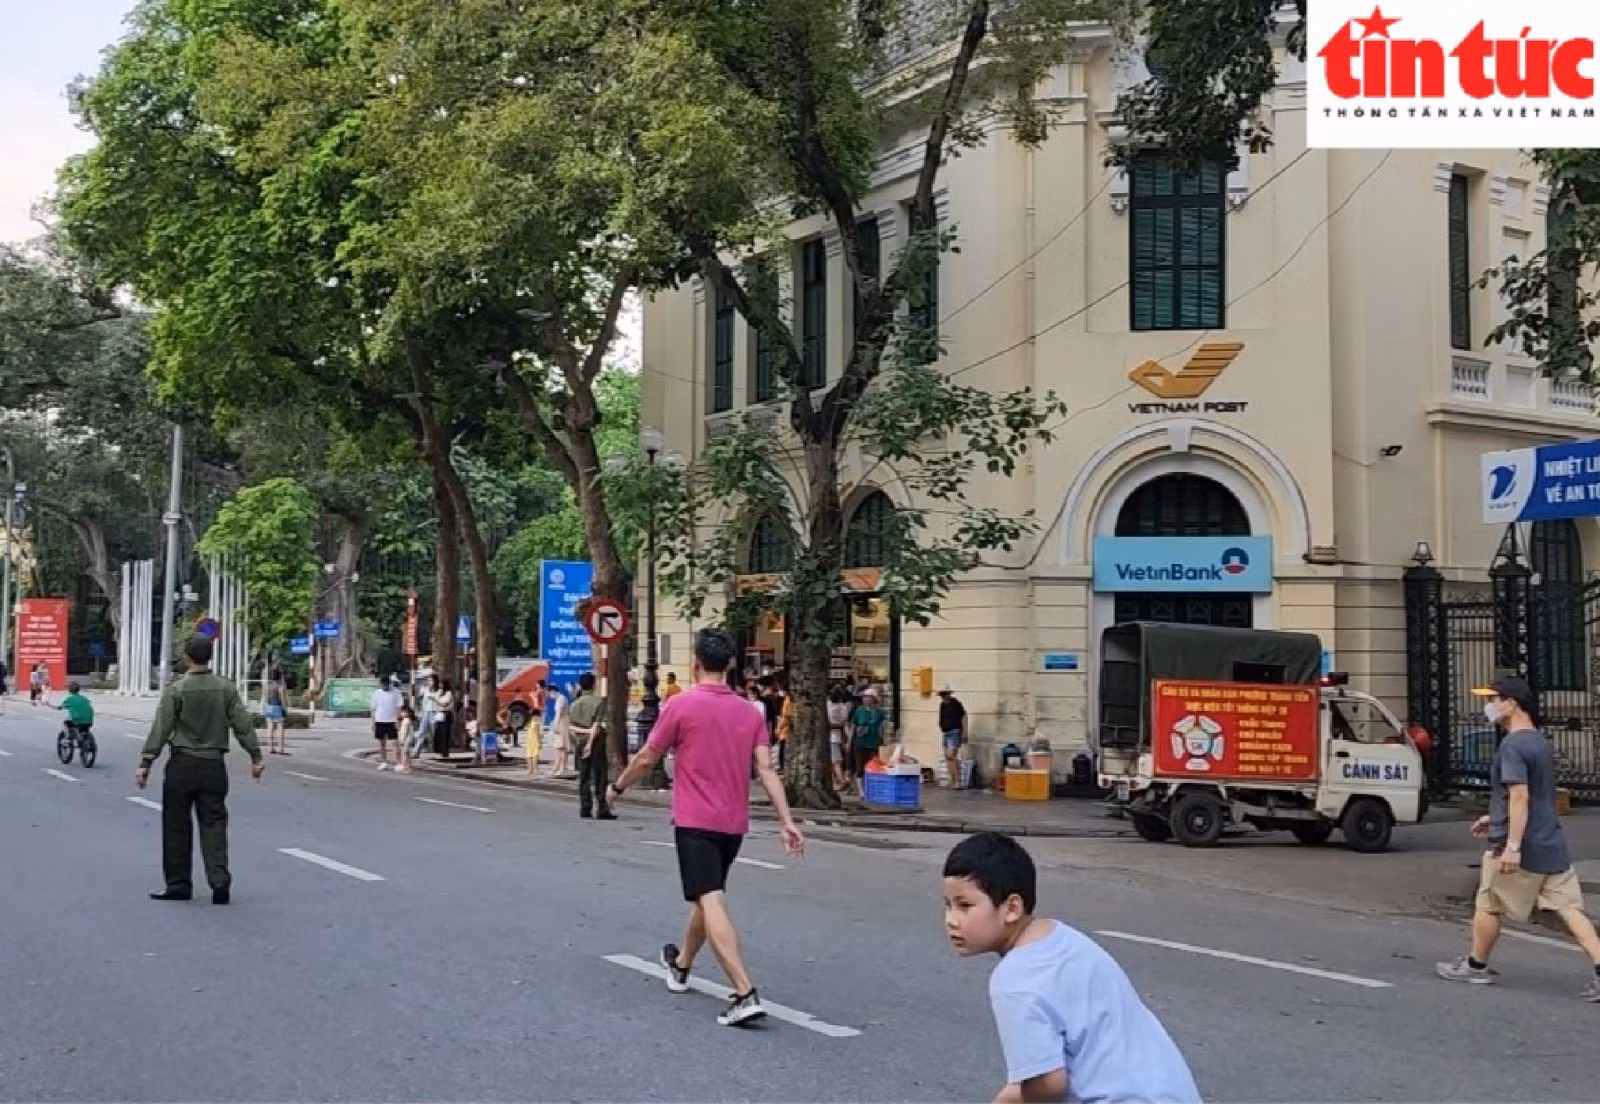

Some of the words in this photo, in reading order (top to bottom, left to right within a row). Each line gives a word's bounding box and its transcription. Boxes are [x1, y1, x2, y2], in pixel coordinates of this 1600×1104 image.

[1128, 402, 1199, 414] VIETNAM
[1204, 401, 1249, 413] POST
[1114, 562, 1222, 581] VietinBank
[1342, 758, 1381, 780] CẢNH
[1384, 761, 1409, 781] SÁT
